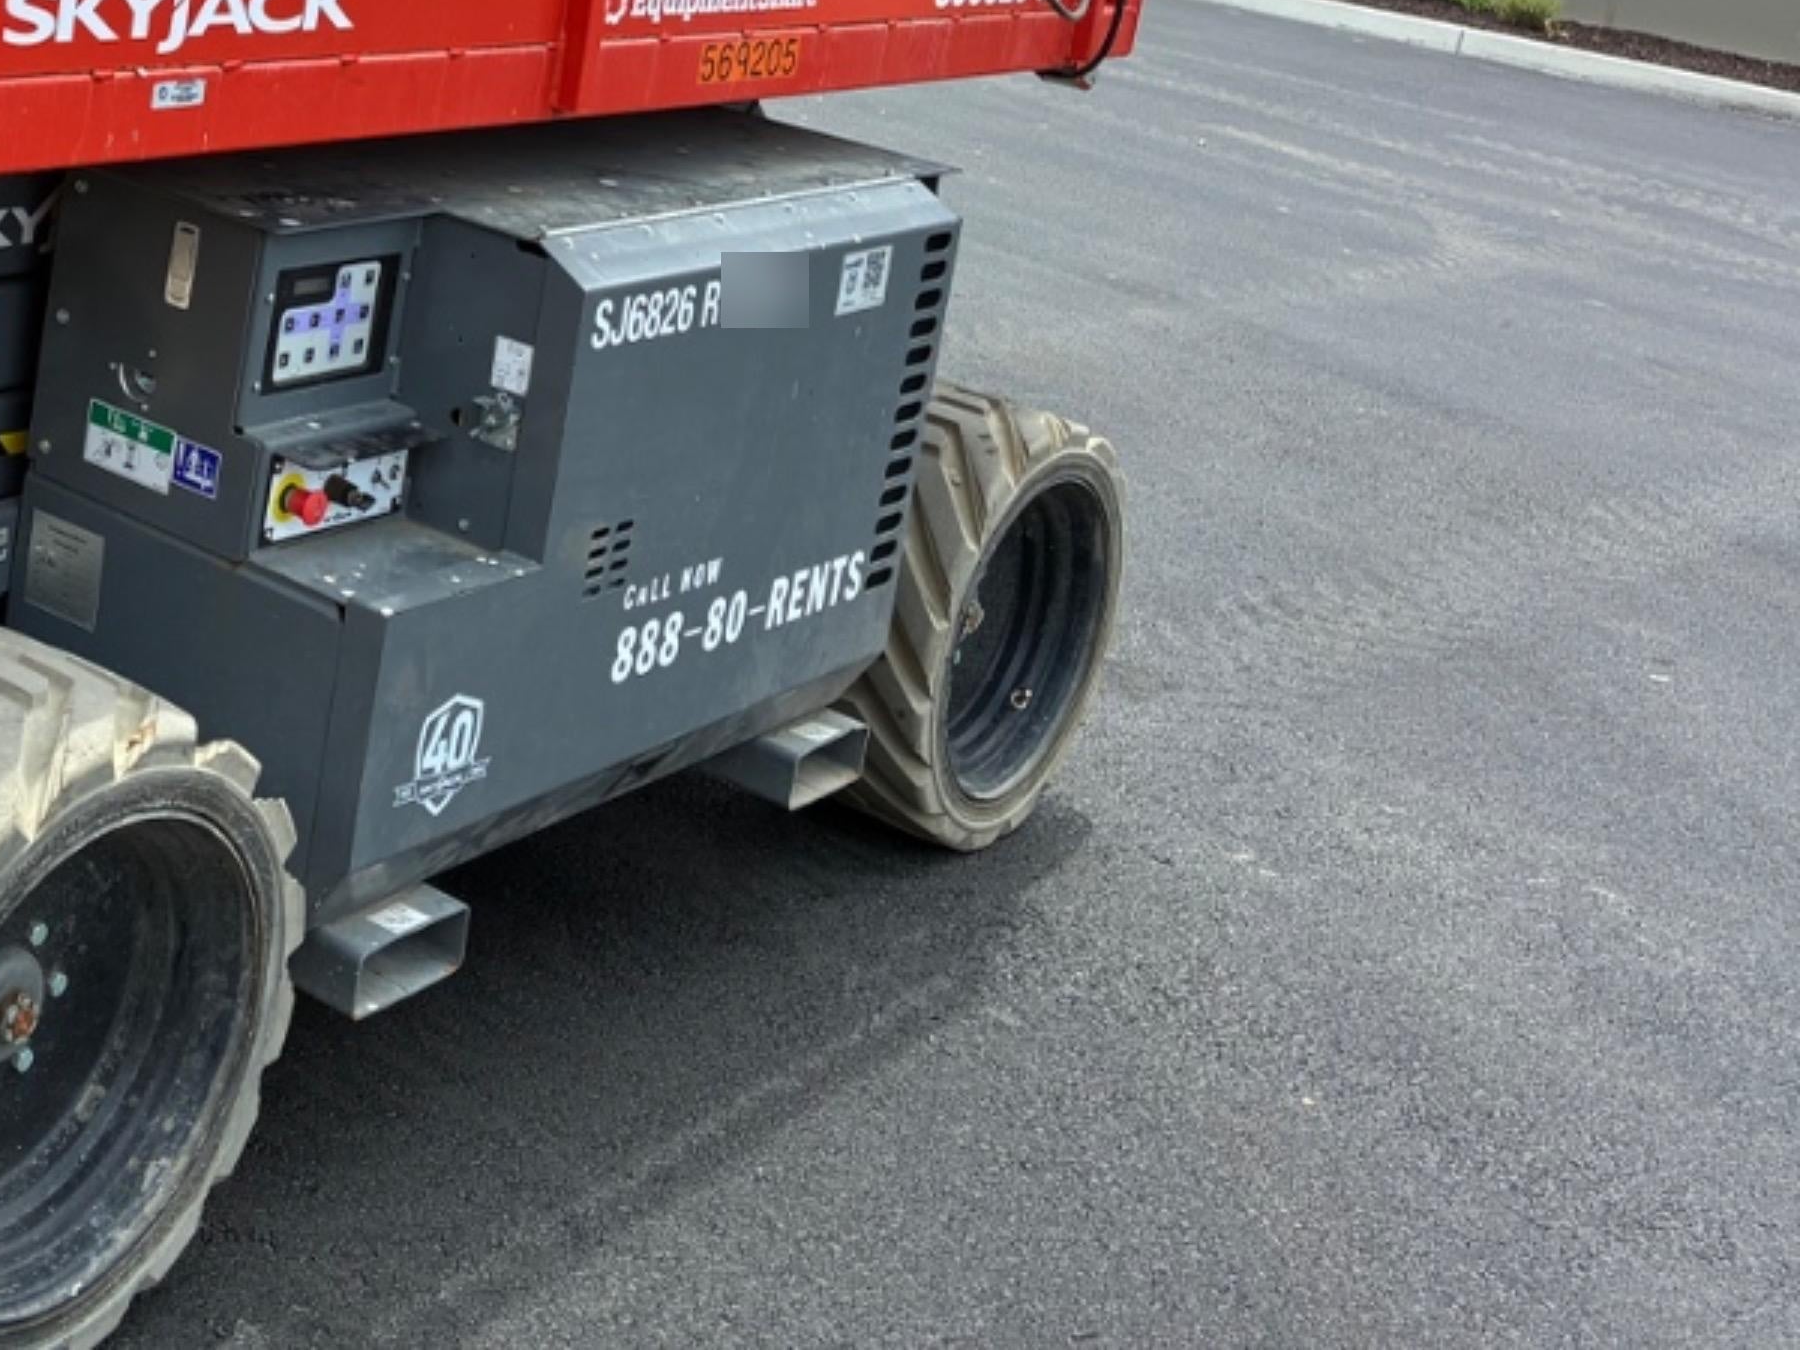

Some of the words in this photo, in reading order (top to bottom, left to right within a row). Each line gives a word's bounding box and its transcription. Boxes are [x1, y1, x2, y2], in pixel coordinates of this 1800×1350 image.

[700, 37, 800, 82] 569205
[590, 283, 698, 351] SJ6826
[700, 279, 723, 329] R
[622, 572, 671, 611] CALL
[679, 556, 725, 594] NOW
[610, 549, 866, 686] 888-80-RENTS
[422, 708, 476, 775] 40
